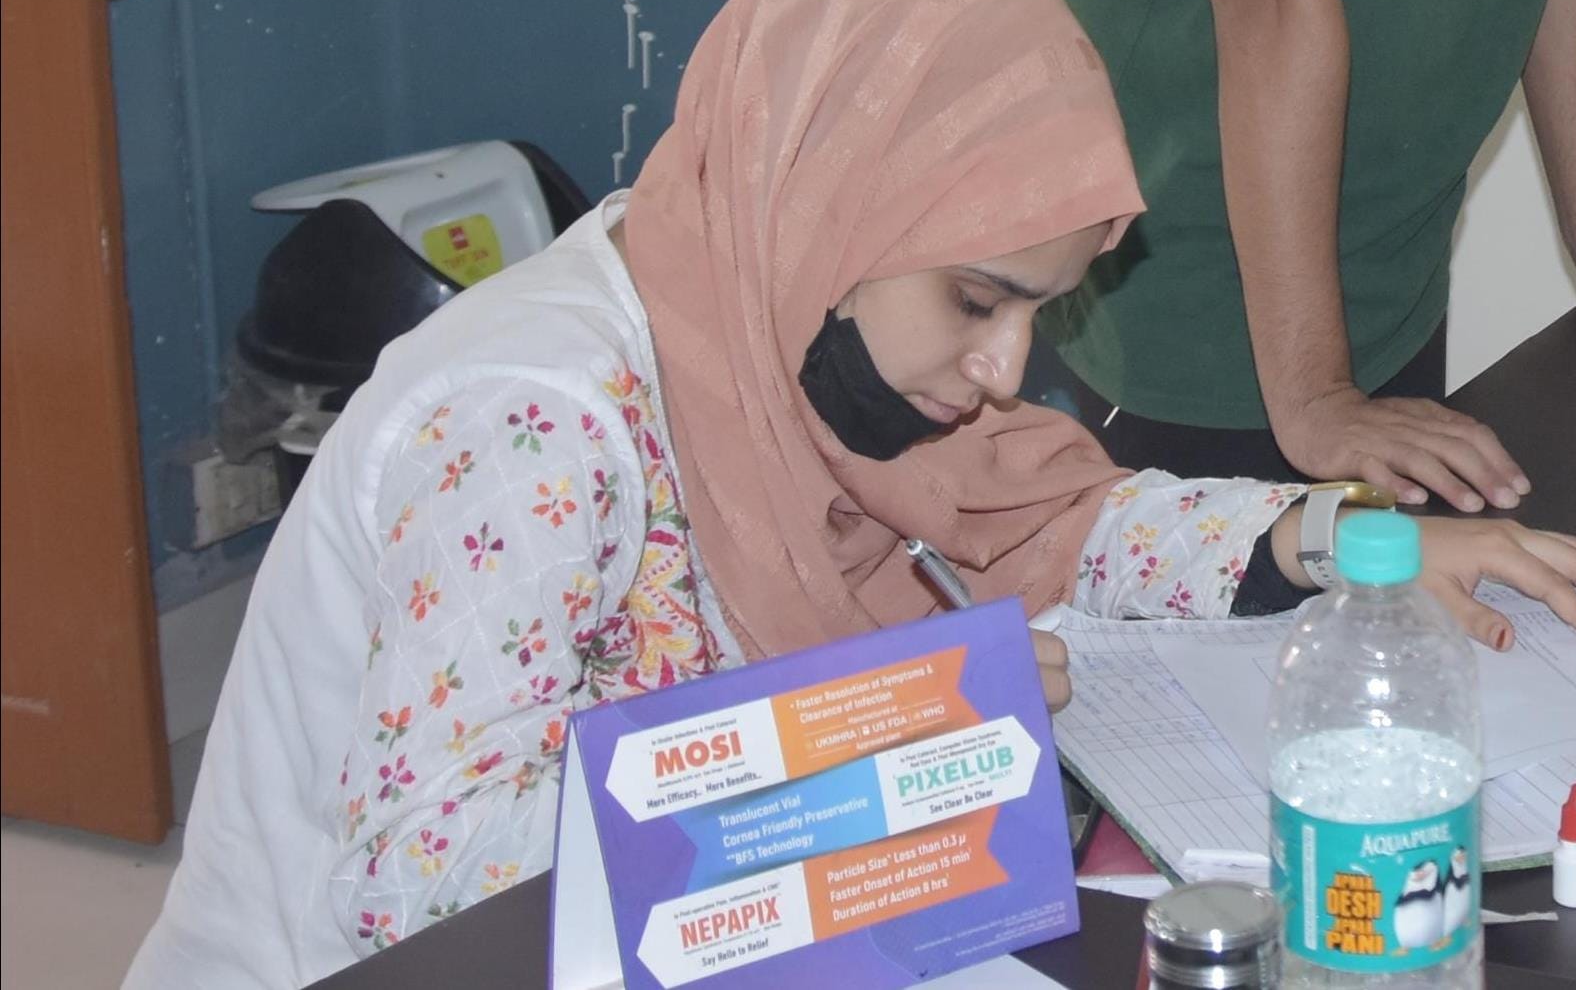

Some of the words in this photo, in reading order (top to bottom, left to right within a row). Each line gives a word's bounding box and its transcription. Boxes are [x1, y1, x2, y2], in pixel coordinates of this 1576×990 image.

[795, 694, 823, 710] Faster
[824, 683, 870, 701] Resolution
[871, 679, 881, 690] of
[881, 668, 926, 688] Symptoms
[926, 663, 934, 675] &
[800, 705, 843, 724] Clearance
[844, 701, 853, 712] of
[854, 691, 893, 709] Infection
[872, 721, 886, 733] US
[887, 716, 908, 730] FDA
[921, 705, 945, 720] WHO
[654, 730, 742, 779] MOSI
[895, 746, 1015, 797] PIXELUB
[705, 781, 725, 793] More
[929, 802, 943, 815] See
[944, 798, 963, 810] Clear
[964, 794, 974, 805] Be
[974, 788, 994, 801] Clear
[718, 801, 781, 829] Translucent
[781, 794, 801, 810] Vial
[723, 829, 760, 848] Cornea
[762, 815, 803, 836] Friendly
[804, 797, 869, 825] Preservative
[756, 833, 814, 859] Technology
[1359, 822, 1453, 859] AQUAPURE
[826, 862, 867, 884] Particle
[893, 849, 917, 864] Less
[917, 841, 941, 856] than
[942, 835, 958, 849] 0.3
[830, 884, 861, 903] Faster
[863, 874, 893, 892] Onset
[894, 869, 906, 883] of
[907, 859, 938, 879] Action
[940, 856, 951, 869] 15
[832, 899, 877, 922] Duration
[877, 895, 888, 908] of
[889, 884, 922, 904] Action
[922, 881, 930, 893] 8
[1326, 886, 1383, 919] DESH
[679, 895, 780, 949] NEPAPIX
[701, 955, 716, 967] Say
[737, 946, 746, 956] to
[747, 938, 769, 953] Relief
[1325, 930, 1385, 956] PANI
